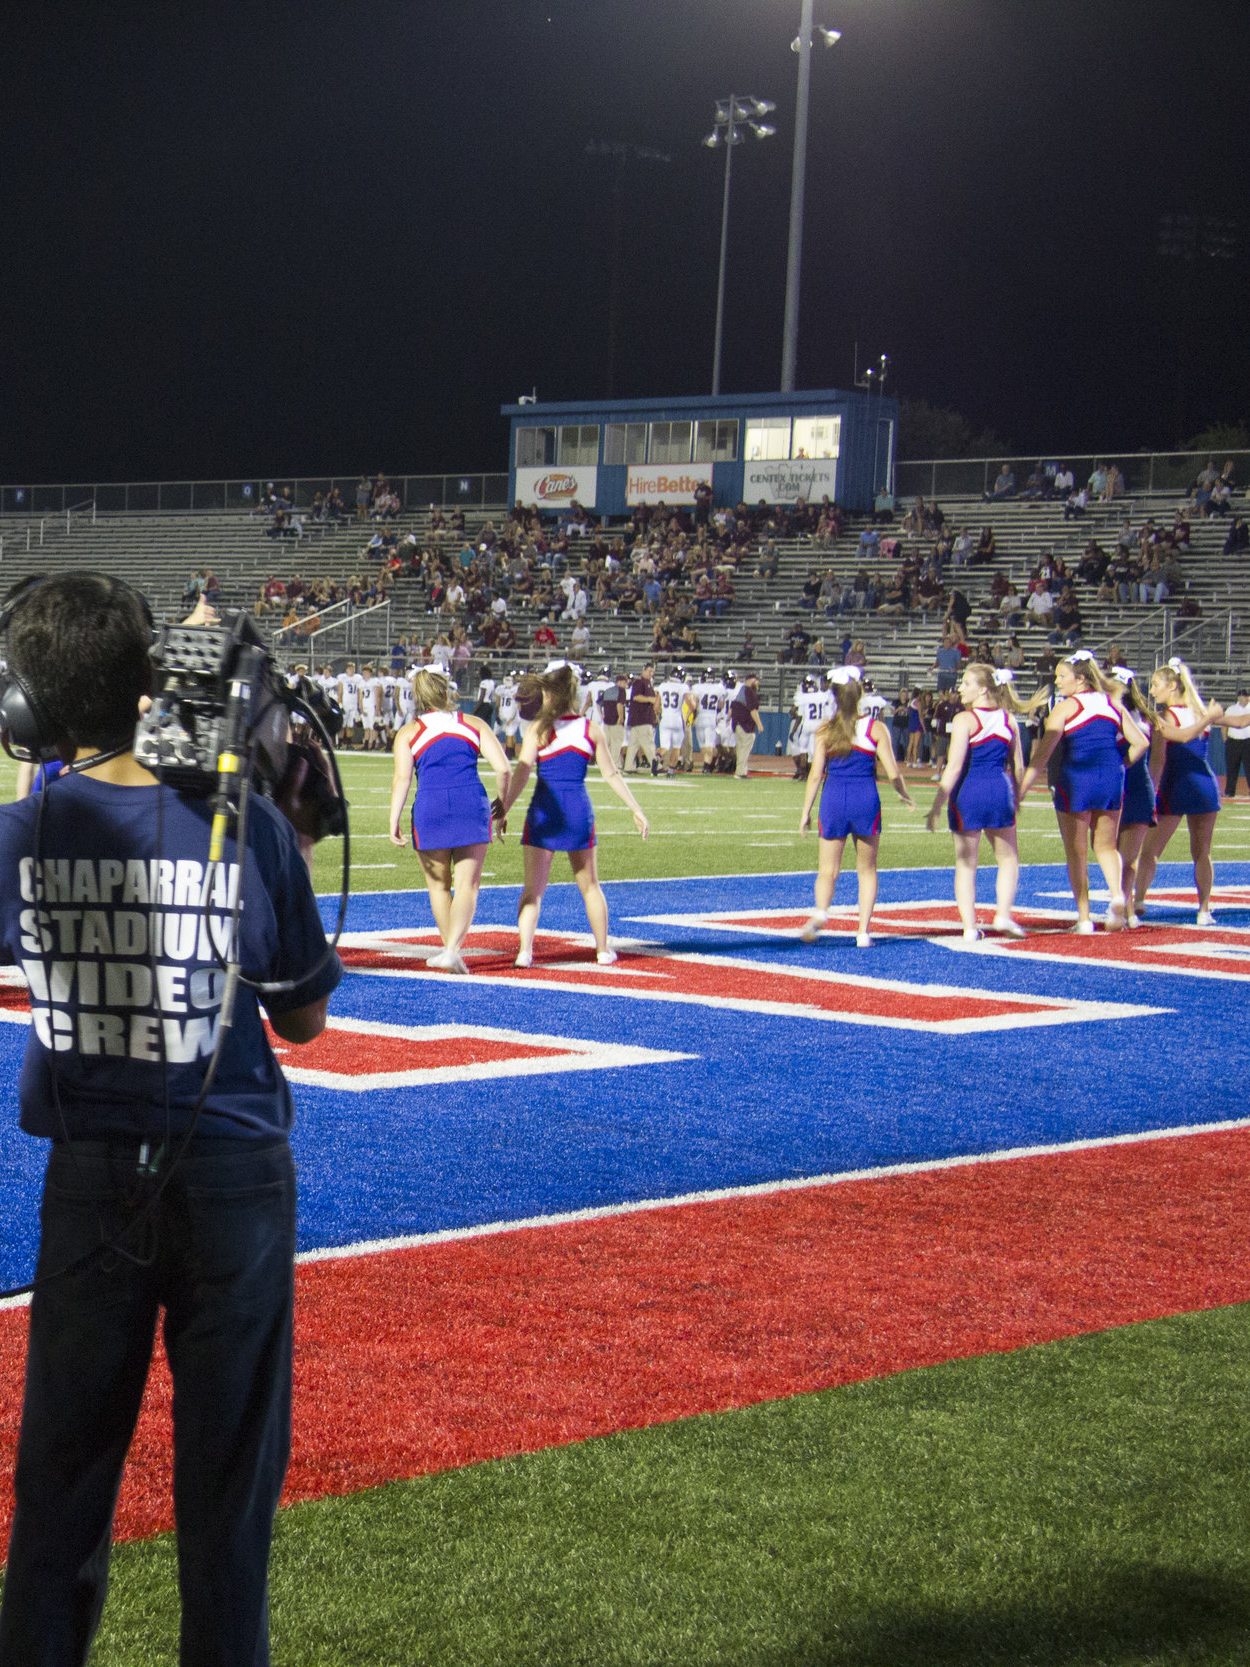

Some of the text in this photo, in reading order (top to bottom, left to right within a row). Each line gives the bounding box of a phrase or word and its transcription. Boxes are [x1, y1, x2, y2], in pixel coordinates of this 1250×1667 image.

[535, 474, 575, 499] Cane's
[750, 472, 830, 484] CENTEX TICKETS
[500, 696, 512, 707] 16
[662, 691, 680, 709] 33
[700, 694, 718, 711] 42
[808, 702, 823, 720] 21
[18, 856, 244, 910] CHAPARRAL
[19, 908, 241, 963] STADIUM
[21, 959, 227, 1013] VIDEO
[31, 1007, 223, 1063] CREW
